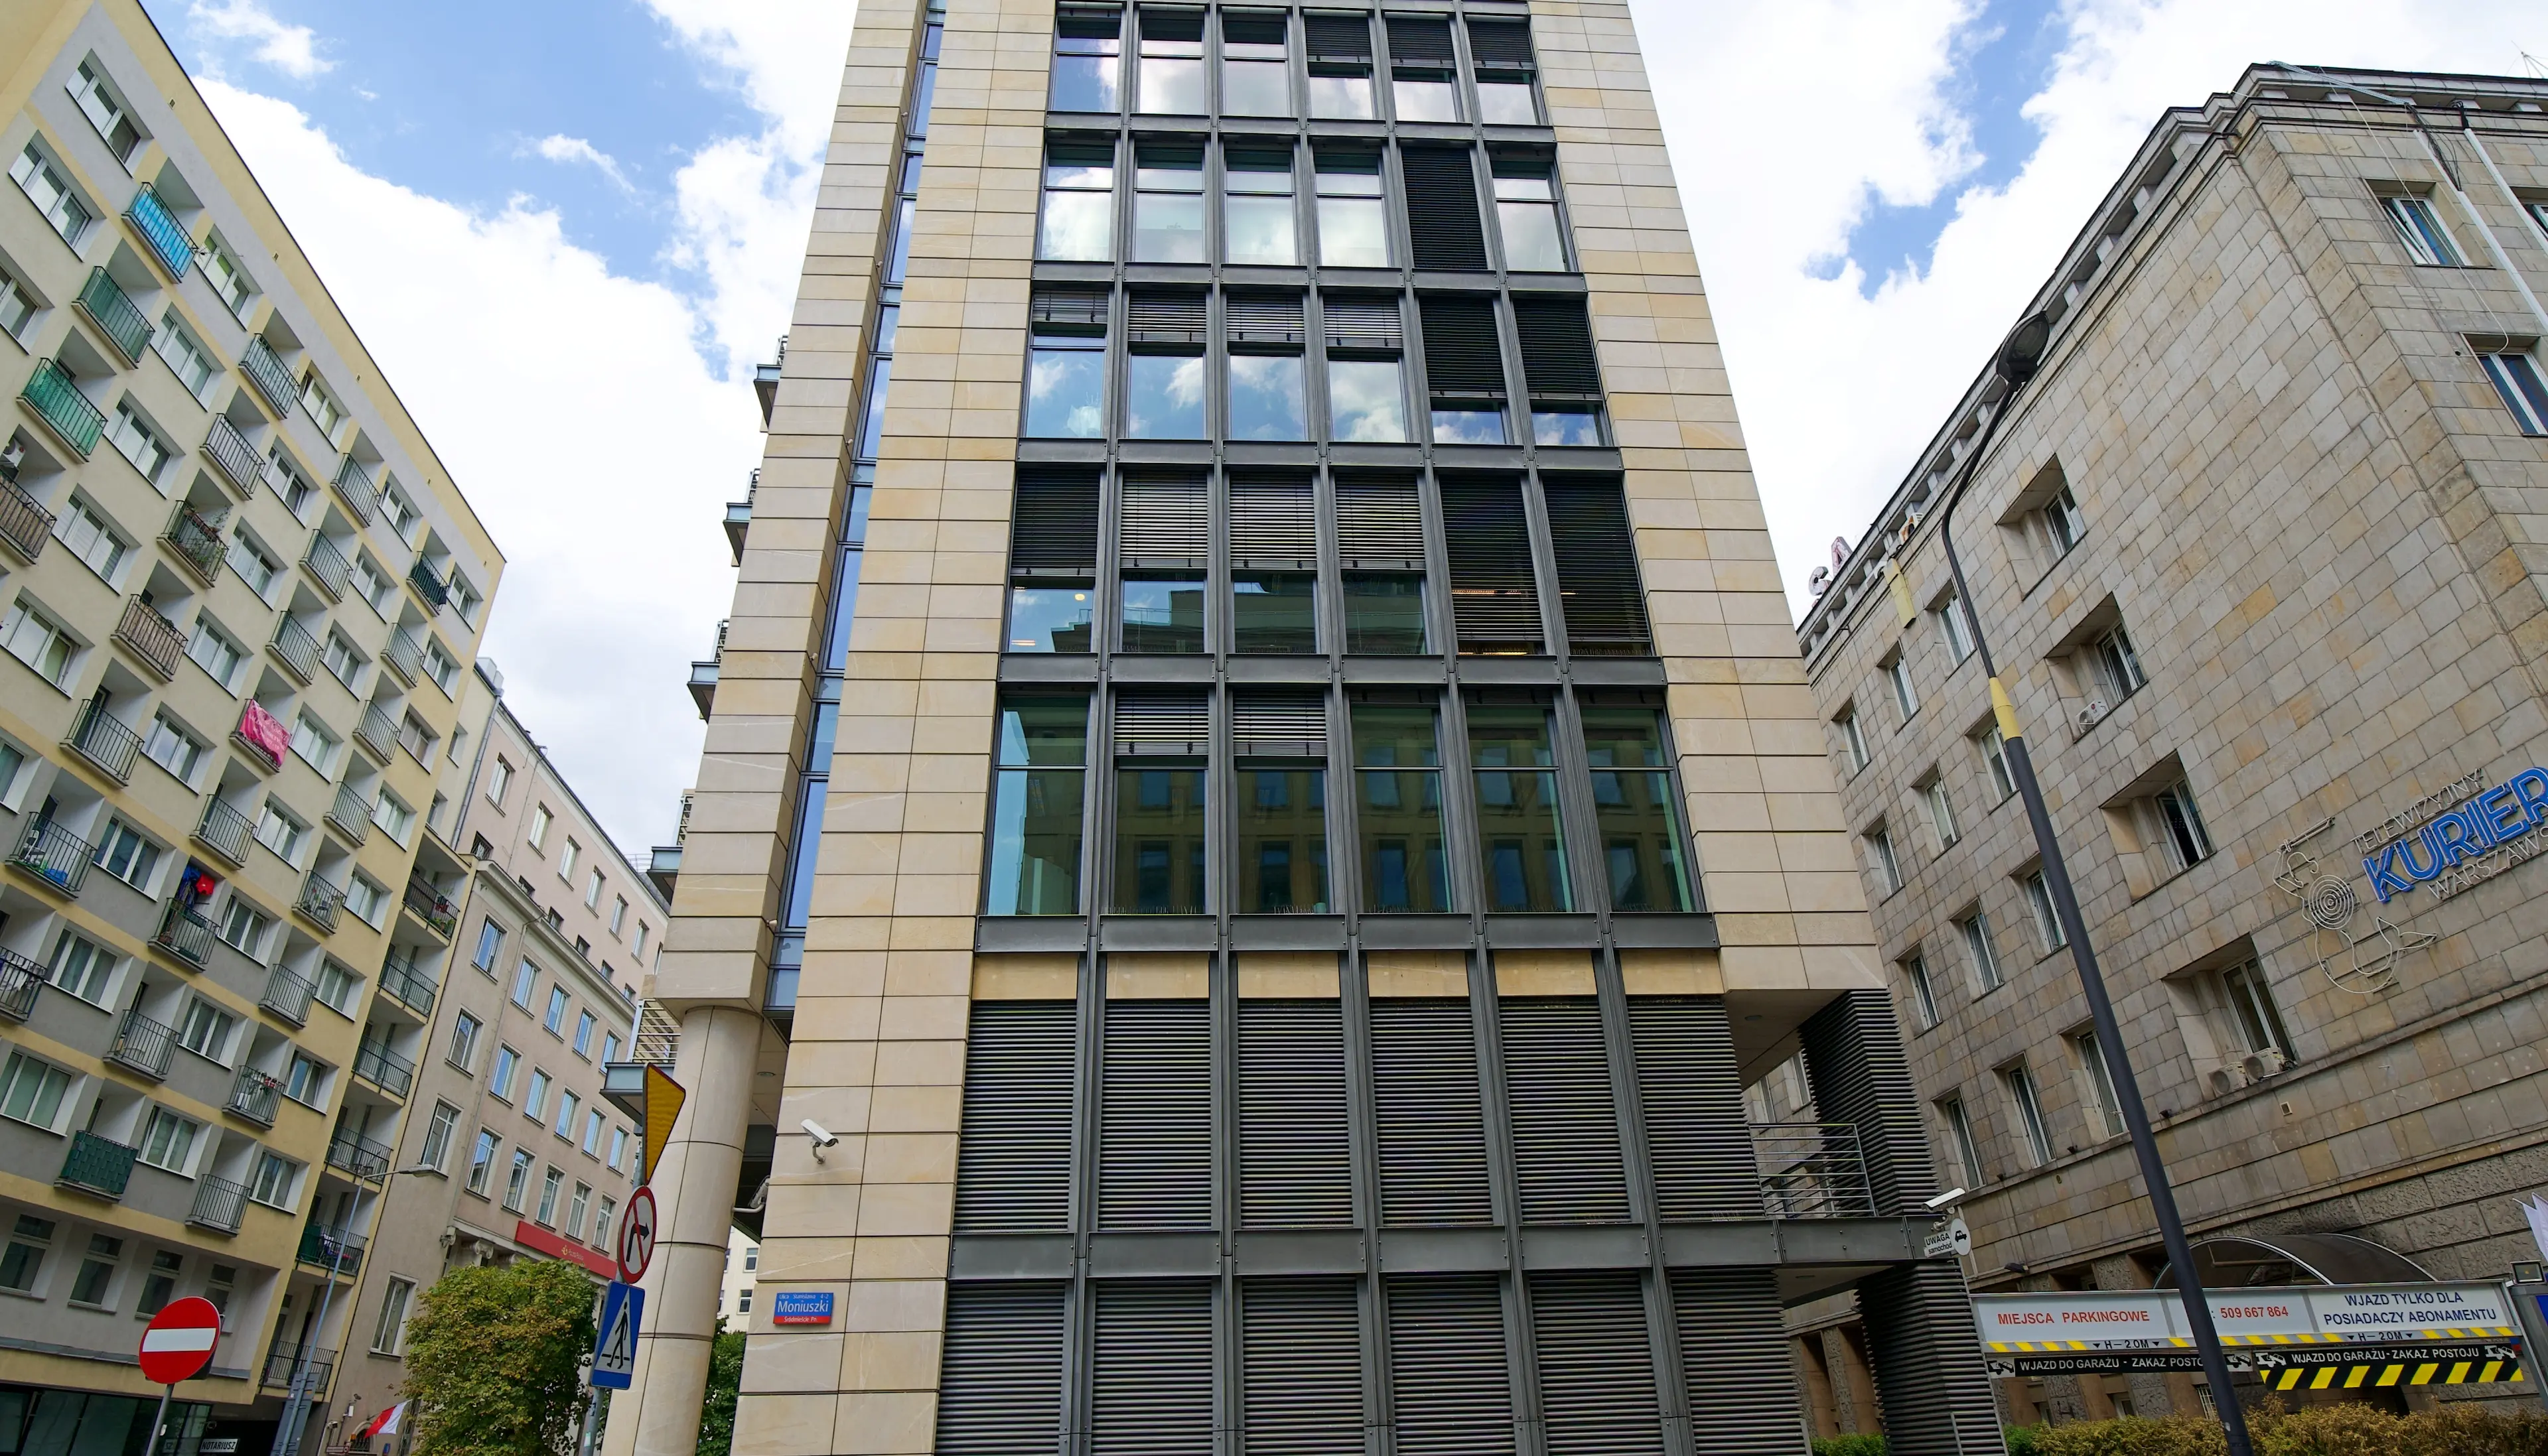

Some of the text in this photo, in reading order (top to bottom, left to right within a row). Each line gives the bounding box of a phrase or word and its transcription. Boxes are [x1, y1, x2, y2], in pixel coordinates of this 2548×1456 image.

[2351, 768, 2484, 854] TELEWIZYJNY
[2362, 767, 2548, 904] KURIER
[1926, 1232, 1950, 1245] UWAGA
[2344, 1292, 2464, 1306] WJAZD TYLKO DLA
[778, 1300, 829, 1313] Moniuszki
[2220, 1307, 2242, 1319] 509
[2245, 1307, 2264, 1317] 667
[2267, 1306, 2289, 1317] 864
[1998, 1311, 2150, 1325] MIEJSCA PARKINGOWE
[2324, 1309, 2496, 1325] POSIADACZY ABONAMENTU
[2291, 1353, 2326, 1363] WJAZD
[2328, 1352, 2342, 1362] DO
[2343, 1348, 2385, 1360] GARAŻU
[2393, 1349, 2428, 1359] ZAKAZ
[2433, 1348, 2479, 1358] POSTOJU
[2020, 1360, 2056, 1370] WJAZD
[2059, 1360, 2074, 1368] DO
[2076, 1357, 2119, 1368] GARAŻU
[2132, 1357, 2166, 1367] ZAKAZ
